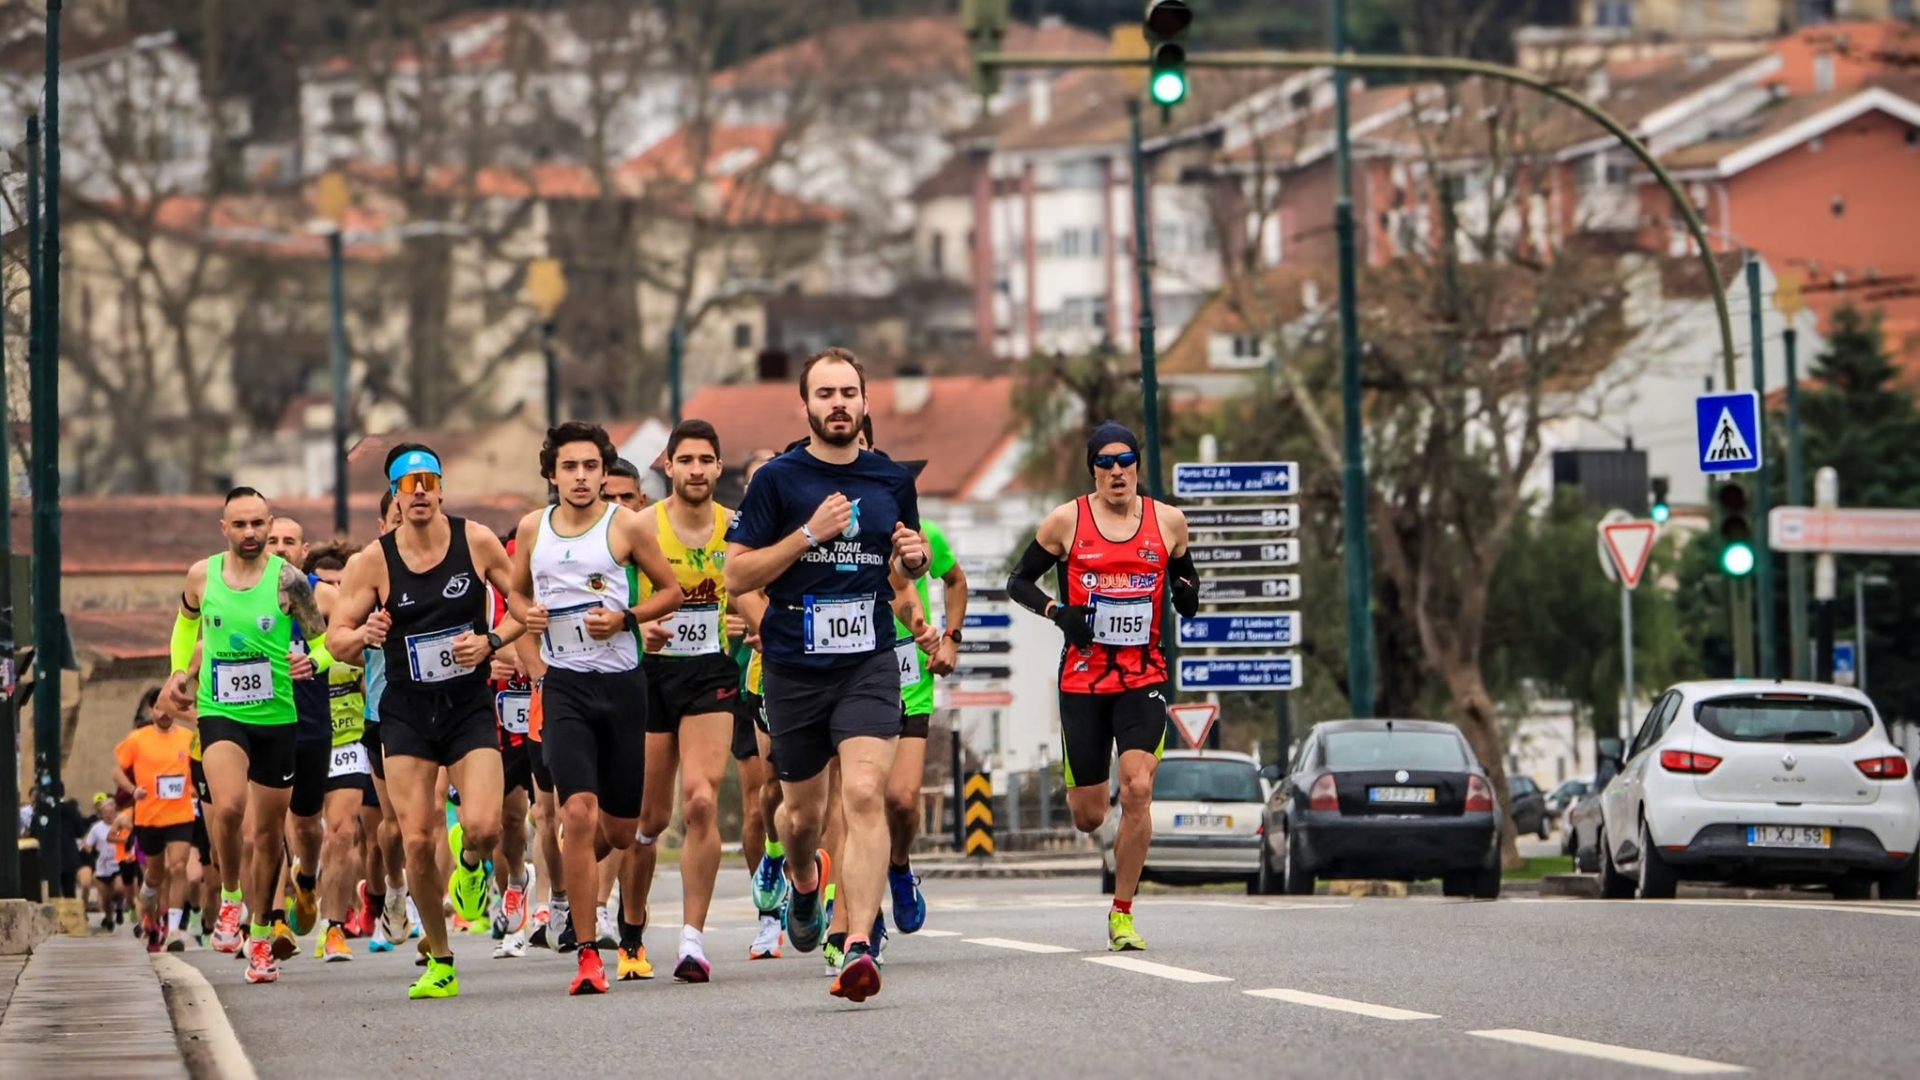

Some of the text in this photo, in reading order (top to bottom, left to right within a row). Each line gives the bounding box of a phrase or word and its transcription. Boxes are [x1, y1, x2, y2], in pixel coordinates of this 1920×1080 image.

[1179, 468, 1201, 478] Porto
[1187, 514, 1215, 524] onvento
[834, 541, 862, 553] TRAIL
[1212, 548, 1242, 560] Clara
[801, 552, 836, 564] PEDRA
[837, 552, 854, 564] DA
[677, 623, 707, 642] 963
[828, 615, 867, 639] 1047
[1109, 615, 1143, 634] 1155
[231, 674, 261, 692] 938
[334, 751, 357, 767] 699
[1756, 827, 1822, 843] 11 XJ 59
